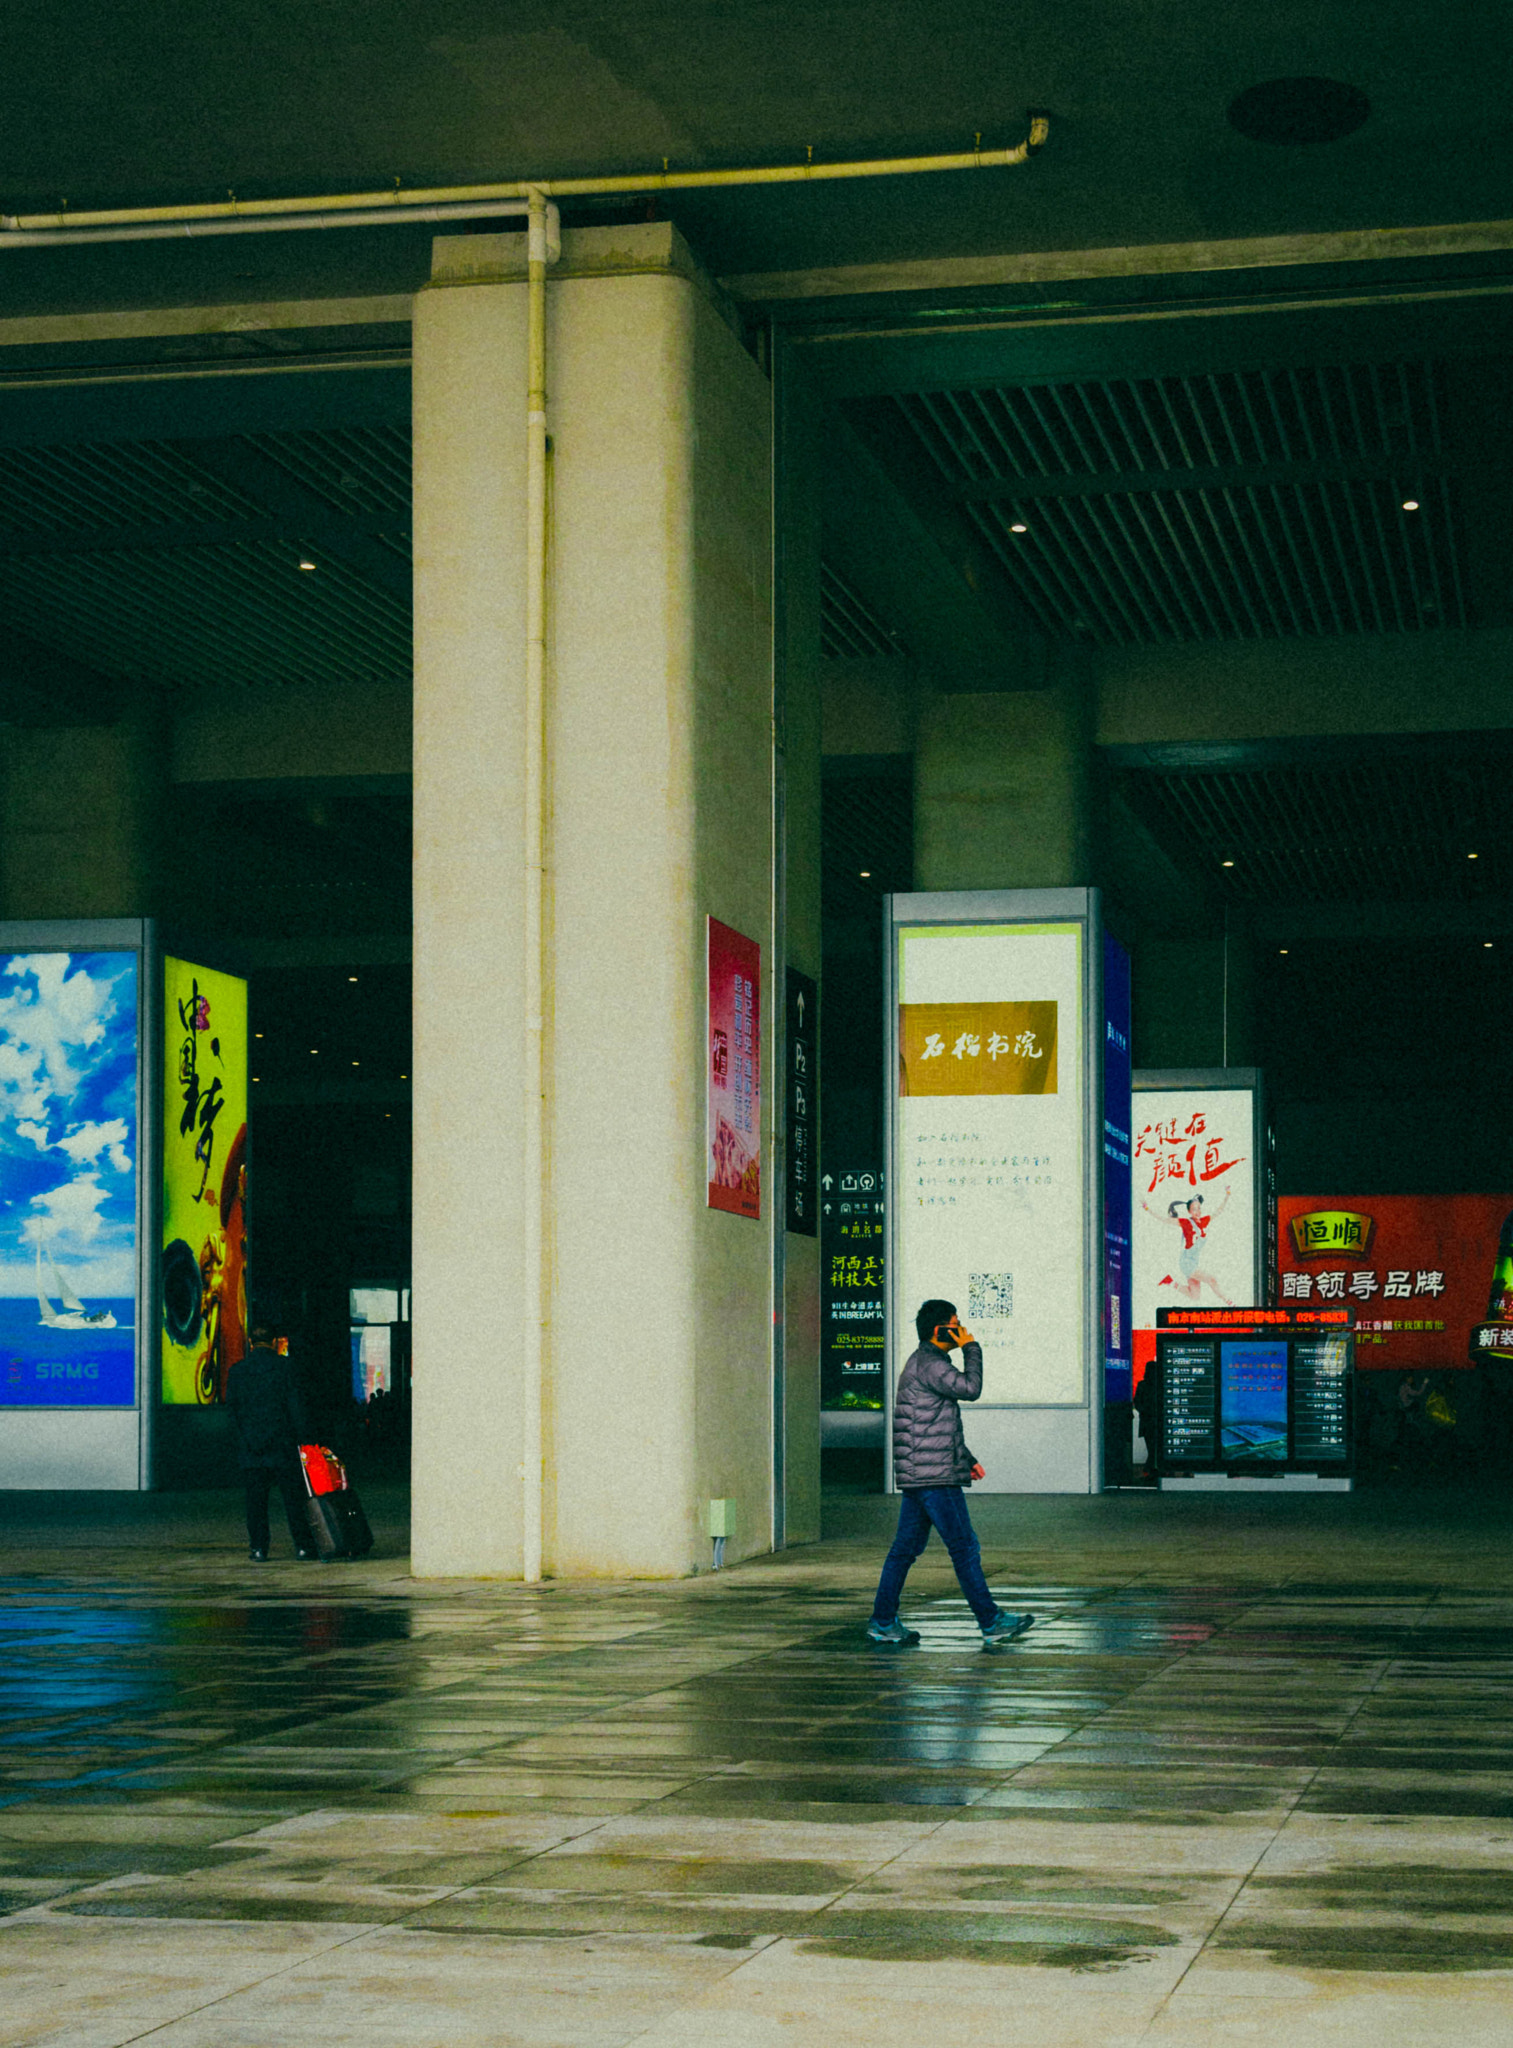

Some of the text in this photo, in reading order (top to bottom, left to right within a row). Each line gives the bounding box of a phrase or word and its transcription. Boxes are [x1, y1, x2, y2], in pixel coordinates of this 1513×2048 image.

[796, 1042, 806, 1073] P2
[796, 1085, 806, 1116] P3
[794, 1125, 804, 1216] 停车场
[1148, 1137, 1247, 1192] 颜值
[832, 1255, 884, 1270] 河西正
[830, 1271, 884, 1288] 科技大
[1282, 1270, 1445, 1300] 醋领导品牌
[35, 1362, 99, 1379] SRMG
